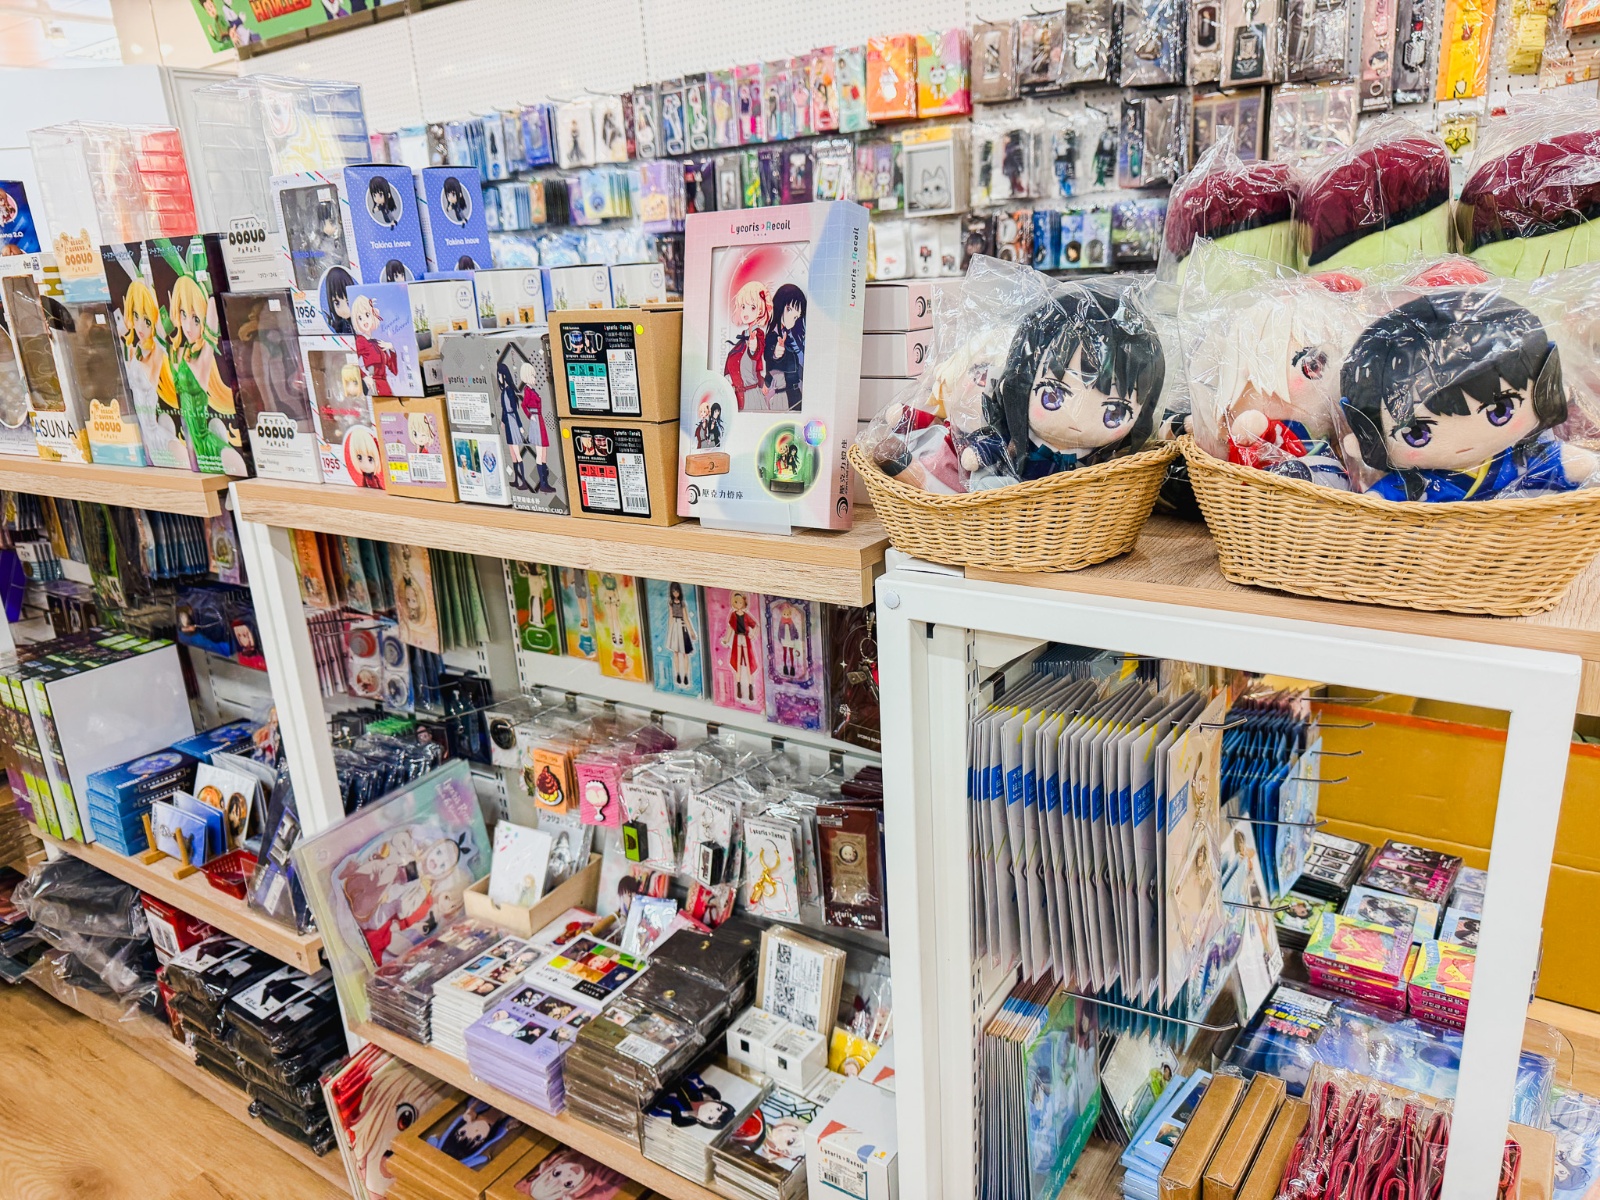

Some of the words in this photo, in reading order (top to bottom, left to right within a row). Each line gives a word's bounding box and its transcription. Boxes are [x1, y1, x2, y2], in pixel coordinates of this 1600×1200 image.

[730, 221, 760, 235] Lycoris
[766, 219, 791, 231] Recoil
[370, 240, 393, 249] Takina
[393, 240, 412, 248] Inoue
[444, 238, 464, 246] Takina
[465, 237, 480, 245] Inoue
[852, 227, 860, 260] Recoil
[849, 268, 857, 307] Lycoris
[295, 306, 316, 318] 1956
[34, 419, 77, 439] ASUNA
[322, 457, 341, 470] 1955
[531, 505, 550, 513] glass
